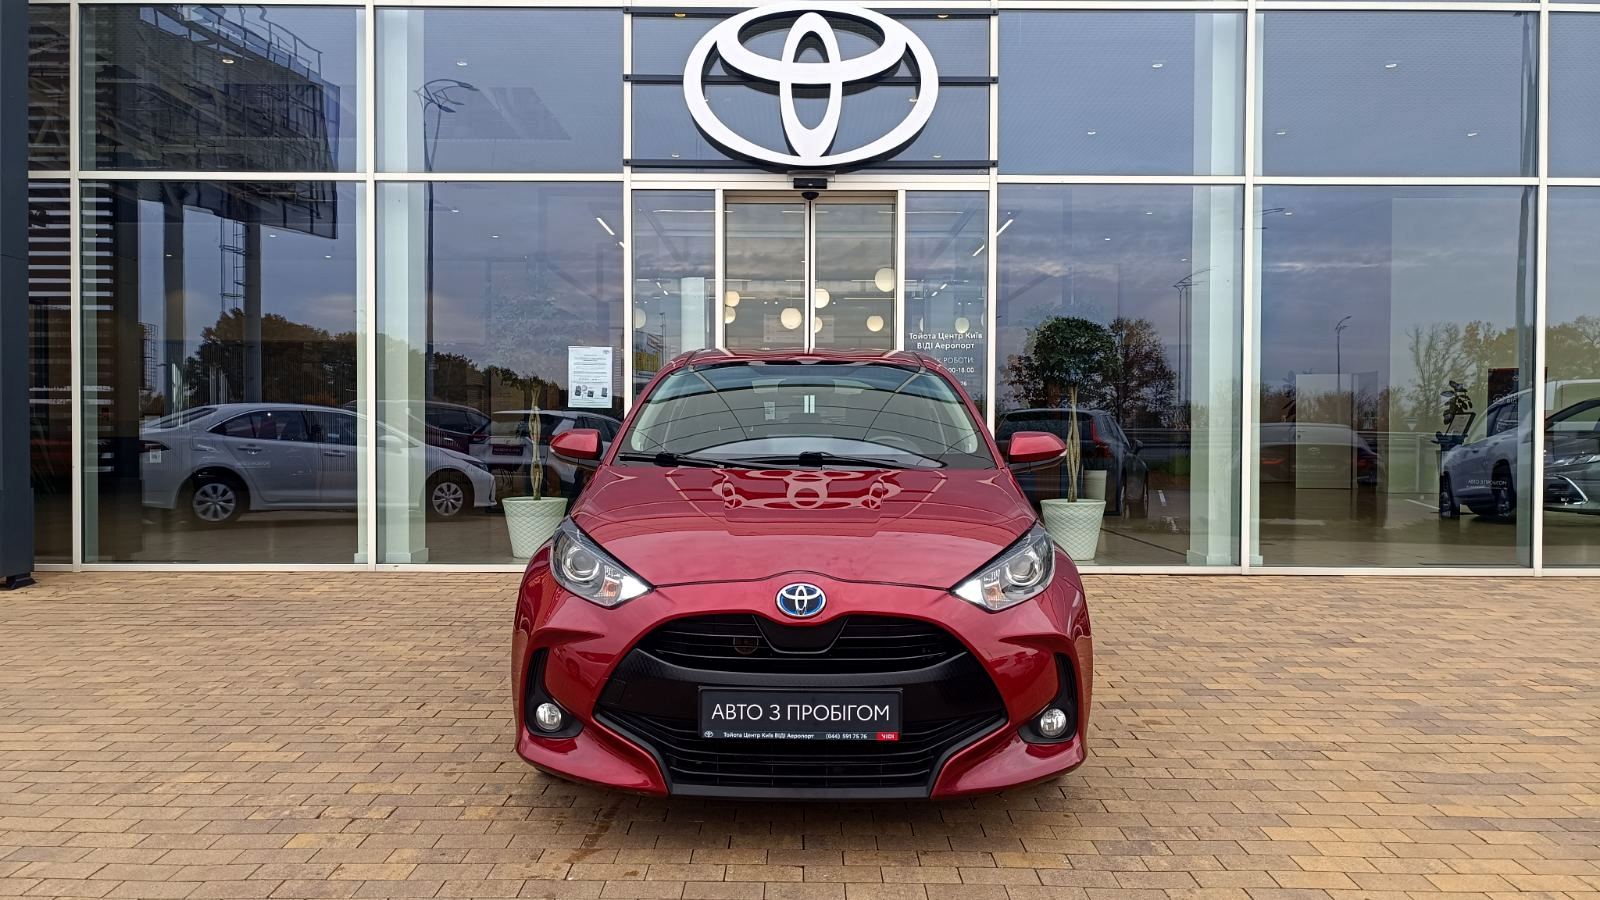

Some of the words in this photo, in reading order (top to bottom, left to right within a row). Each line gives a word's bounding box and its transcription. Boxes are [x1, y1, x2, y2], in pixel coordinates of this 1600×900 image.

[909, 332, 937, 340] Тойота
[938, 332, 964, 341] Центр
[965, 331, 983, 339] Київ
[916, 342, 933, 350] ВІДІ
[934, 342, 975, 351] Аеропорт
[711, 703, 763, 721] АВТО
[768, 704, 781, 721] З
[787, 704, 890, 721] ПРОБІГОМ
[723, 731, 743, 739] Тойота
[743, 732, 761, 740] Центр
